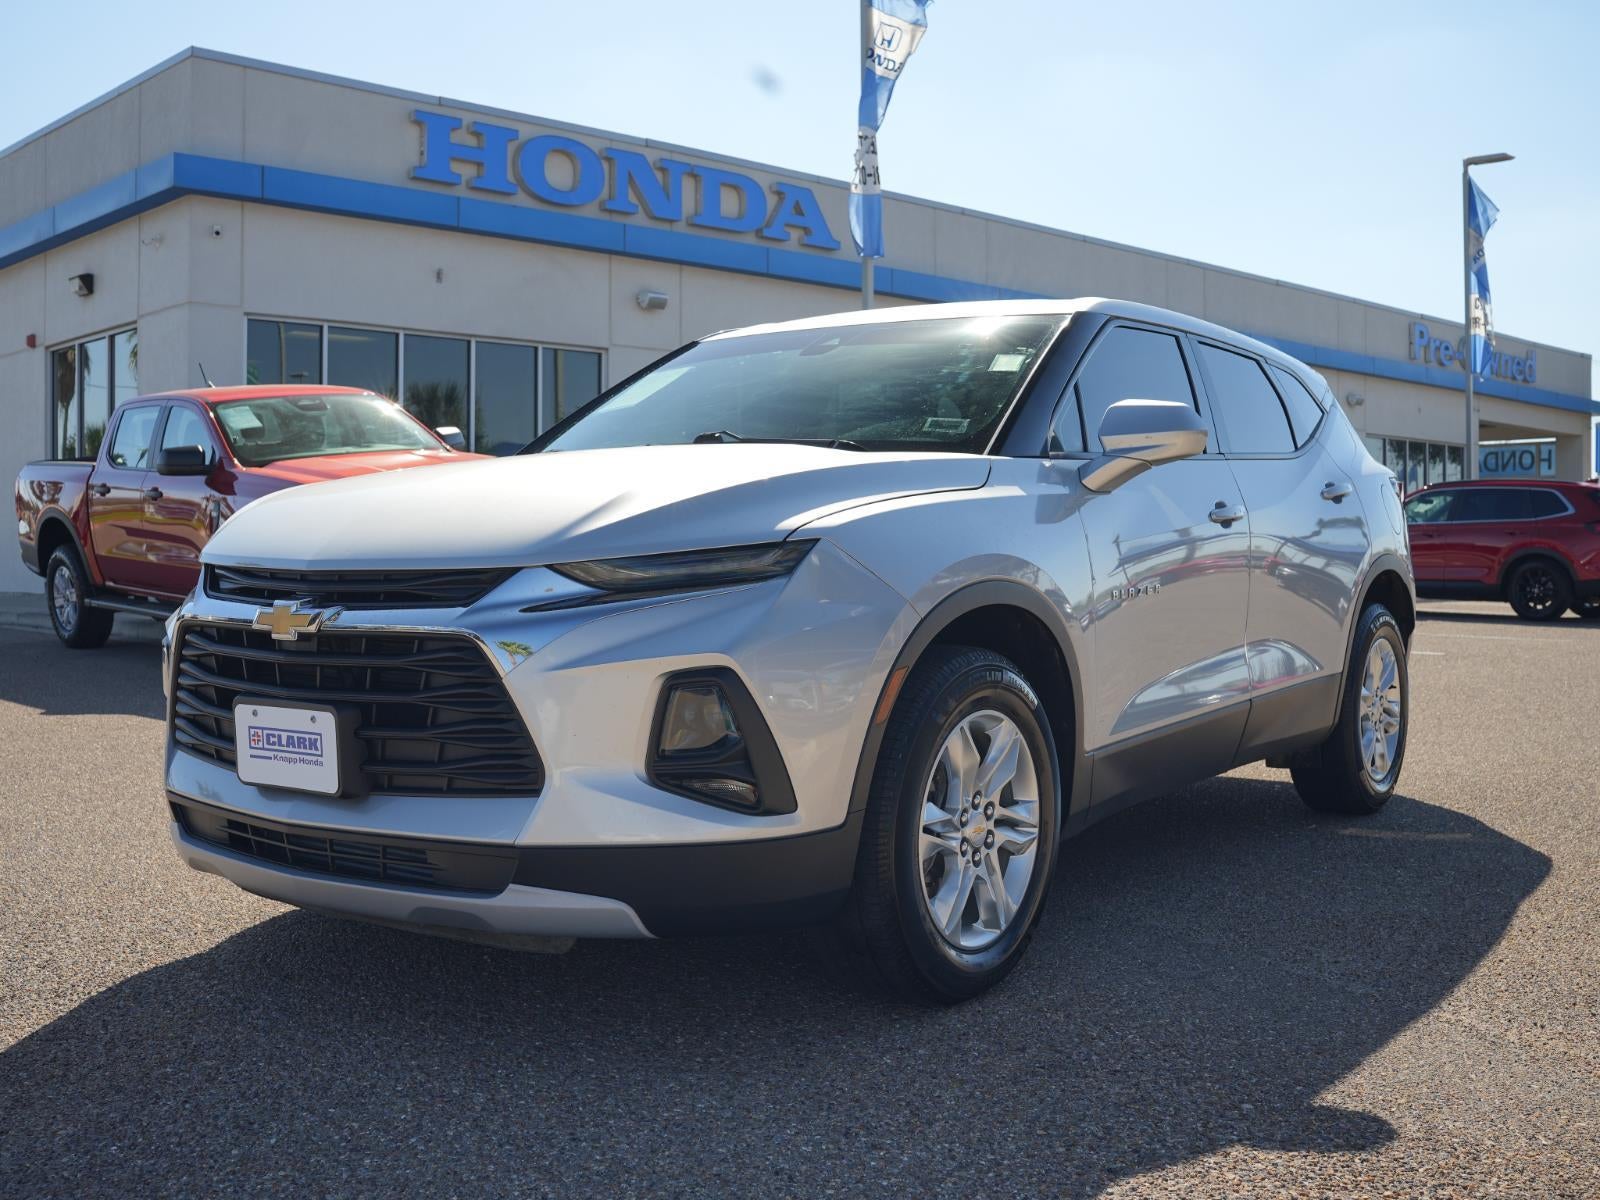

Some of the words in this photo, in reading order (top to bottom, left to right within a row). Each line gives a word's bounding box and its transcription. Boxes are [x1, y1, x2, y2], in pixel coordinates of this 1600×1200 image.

[864, 47, 904, 73] ONDA
[409, 108, 841, 251] HONDA
[1409, 321, 1537, 384] Pre-ned
[265, 732, 320, 752] CLARK
[273, 753, 298, 765] Knapp
[298, 756, 324, 767] Honda
